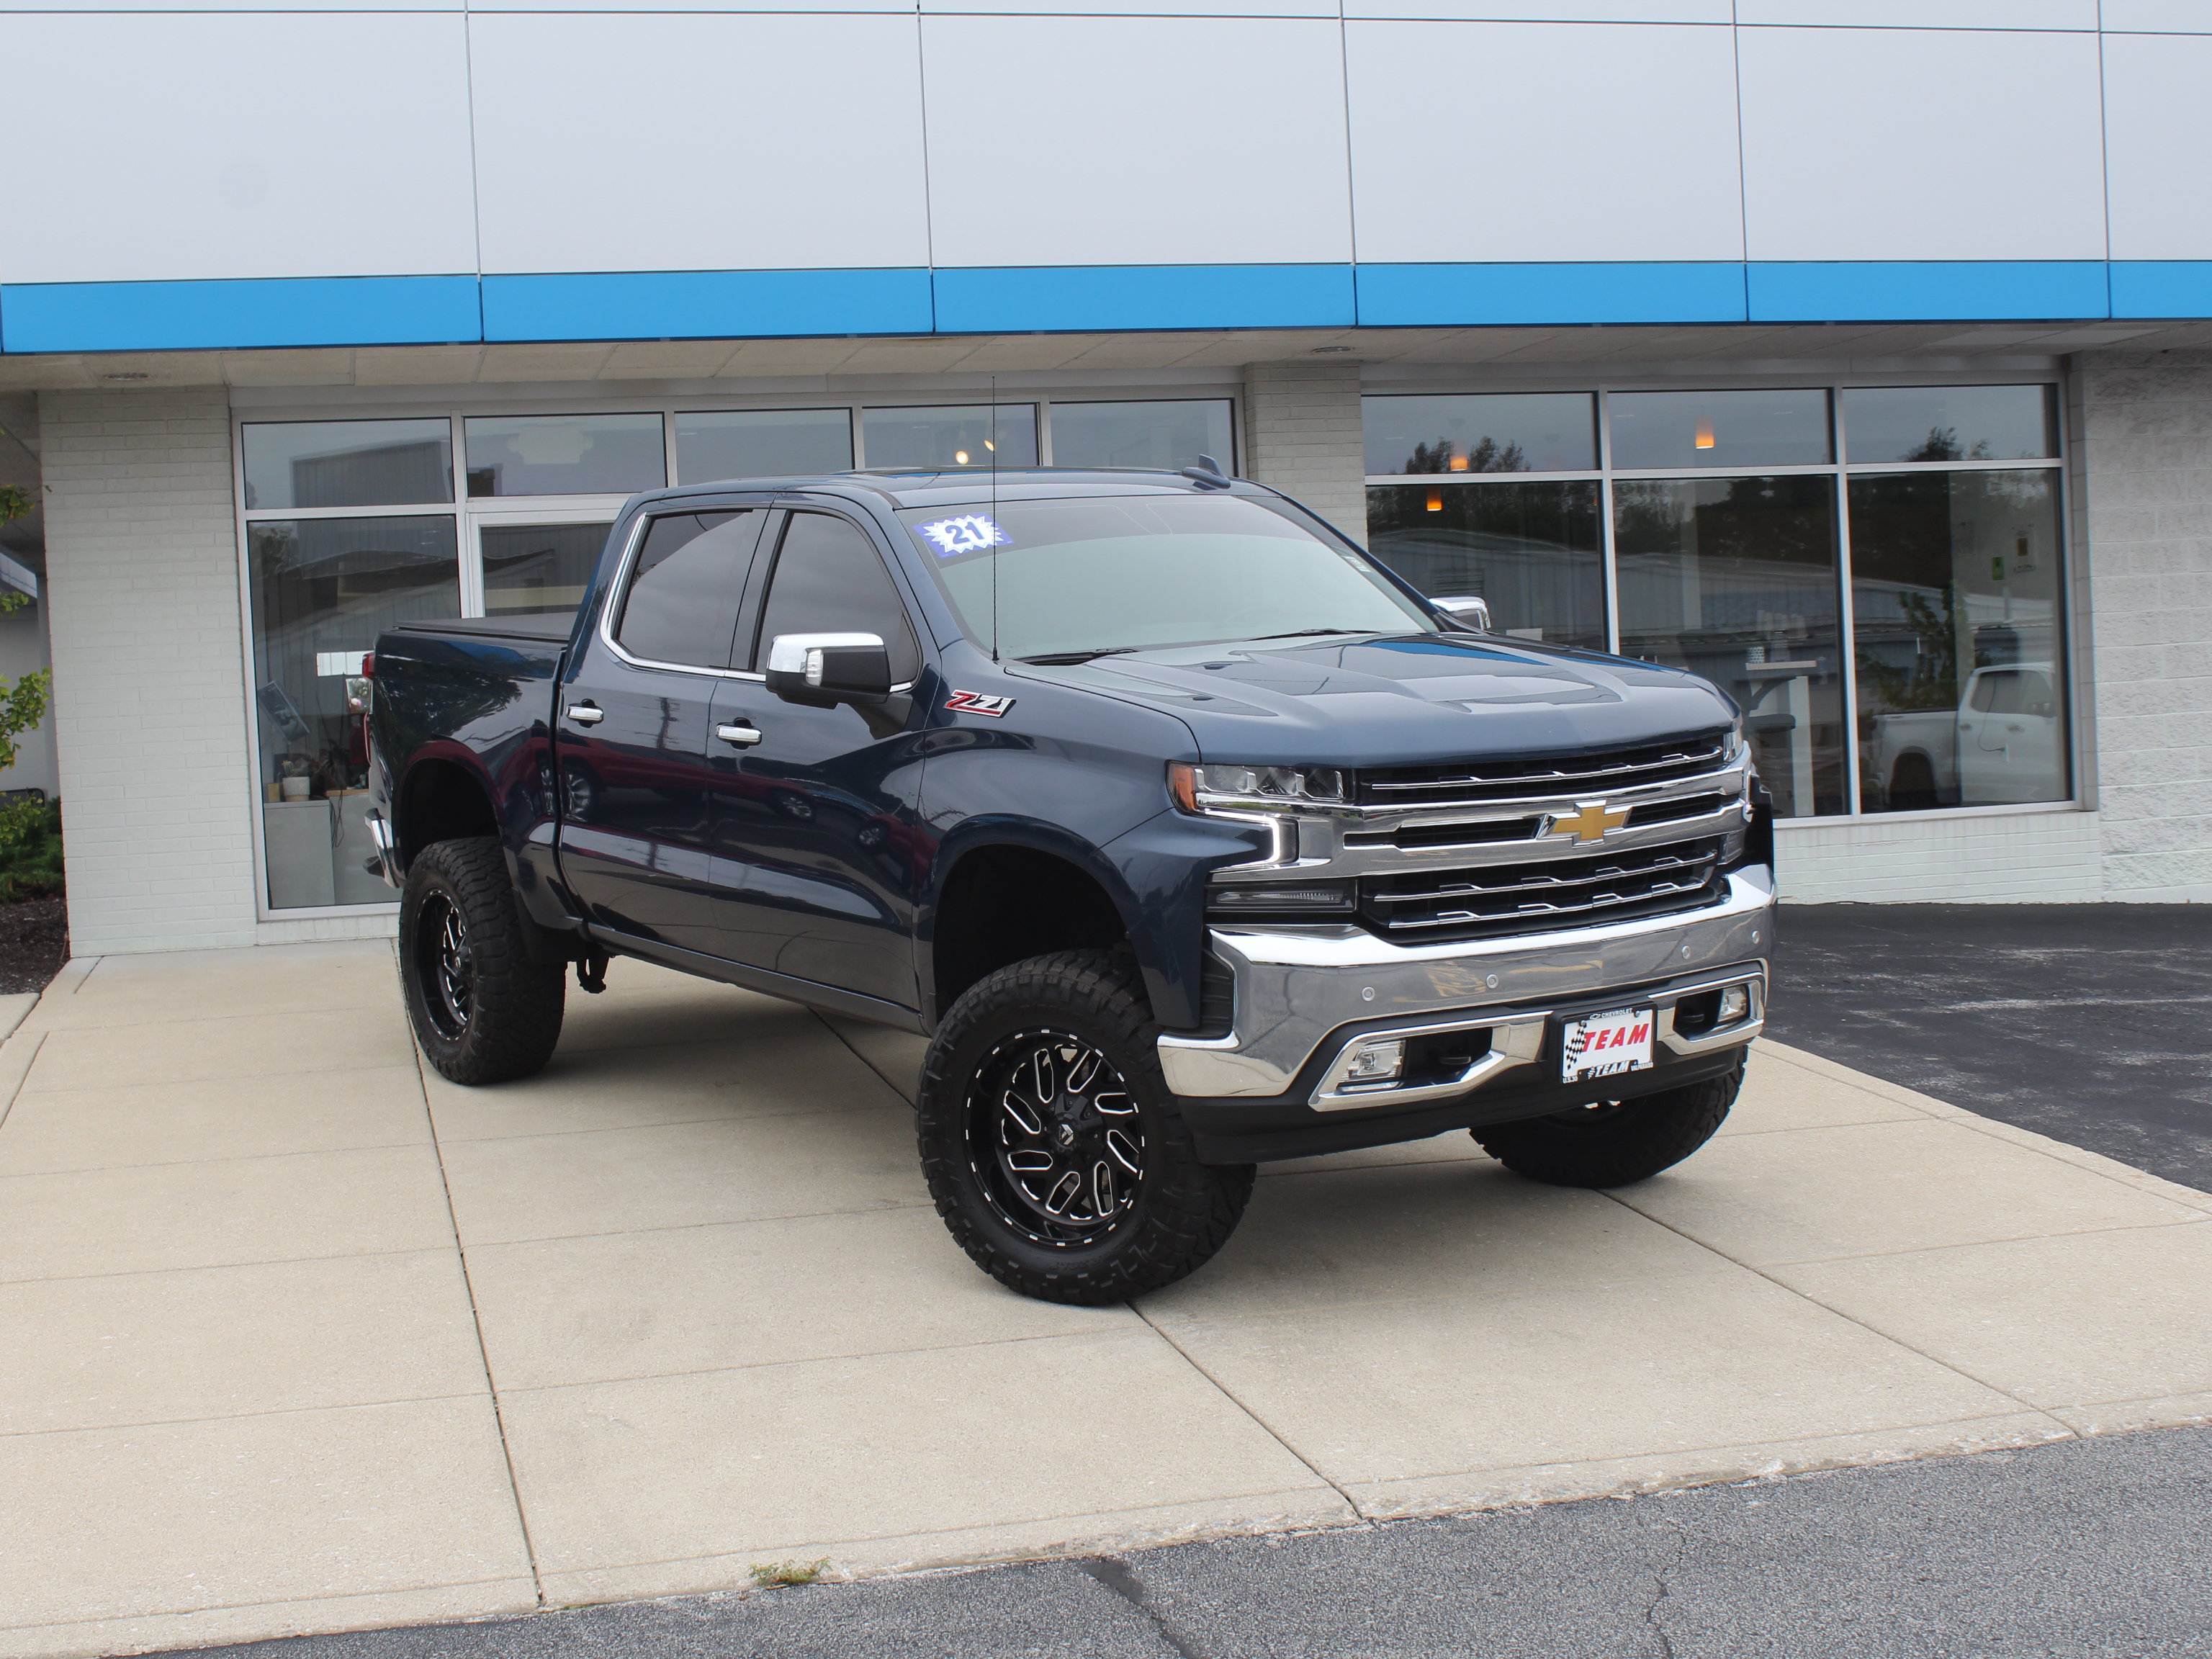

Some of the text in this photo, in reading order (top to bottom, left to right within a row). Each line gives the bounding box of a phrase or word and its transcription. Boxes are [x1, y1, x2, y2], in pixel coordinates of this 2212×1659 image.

[945, 521, 984, 544] 21
[944, 689, 1016, 717] Z71
[1601, 1007, 1633, 1018] CHEVROLET
[1583, 1023, 1649, 1052] TEAM
[1595, 1060, 1630, 1077] TEAM
